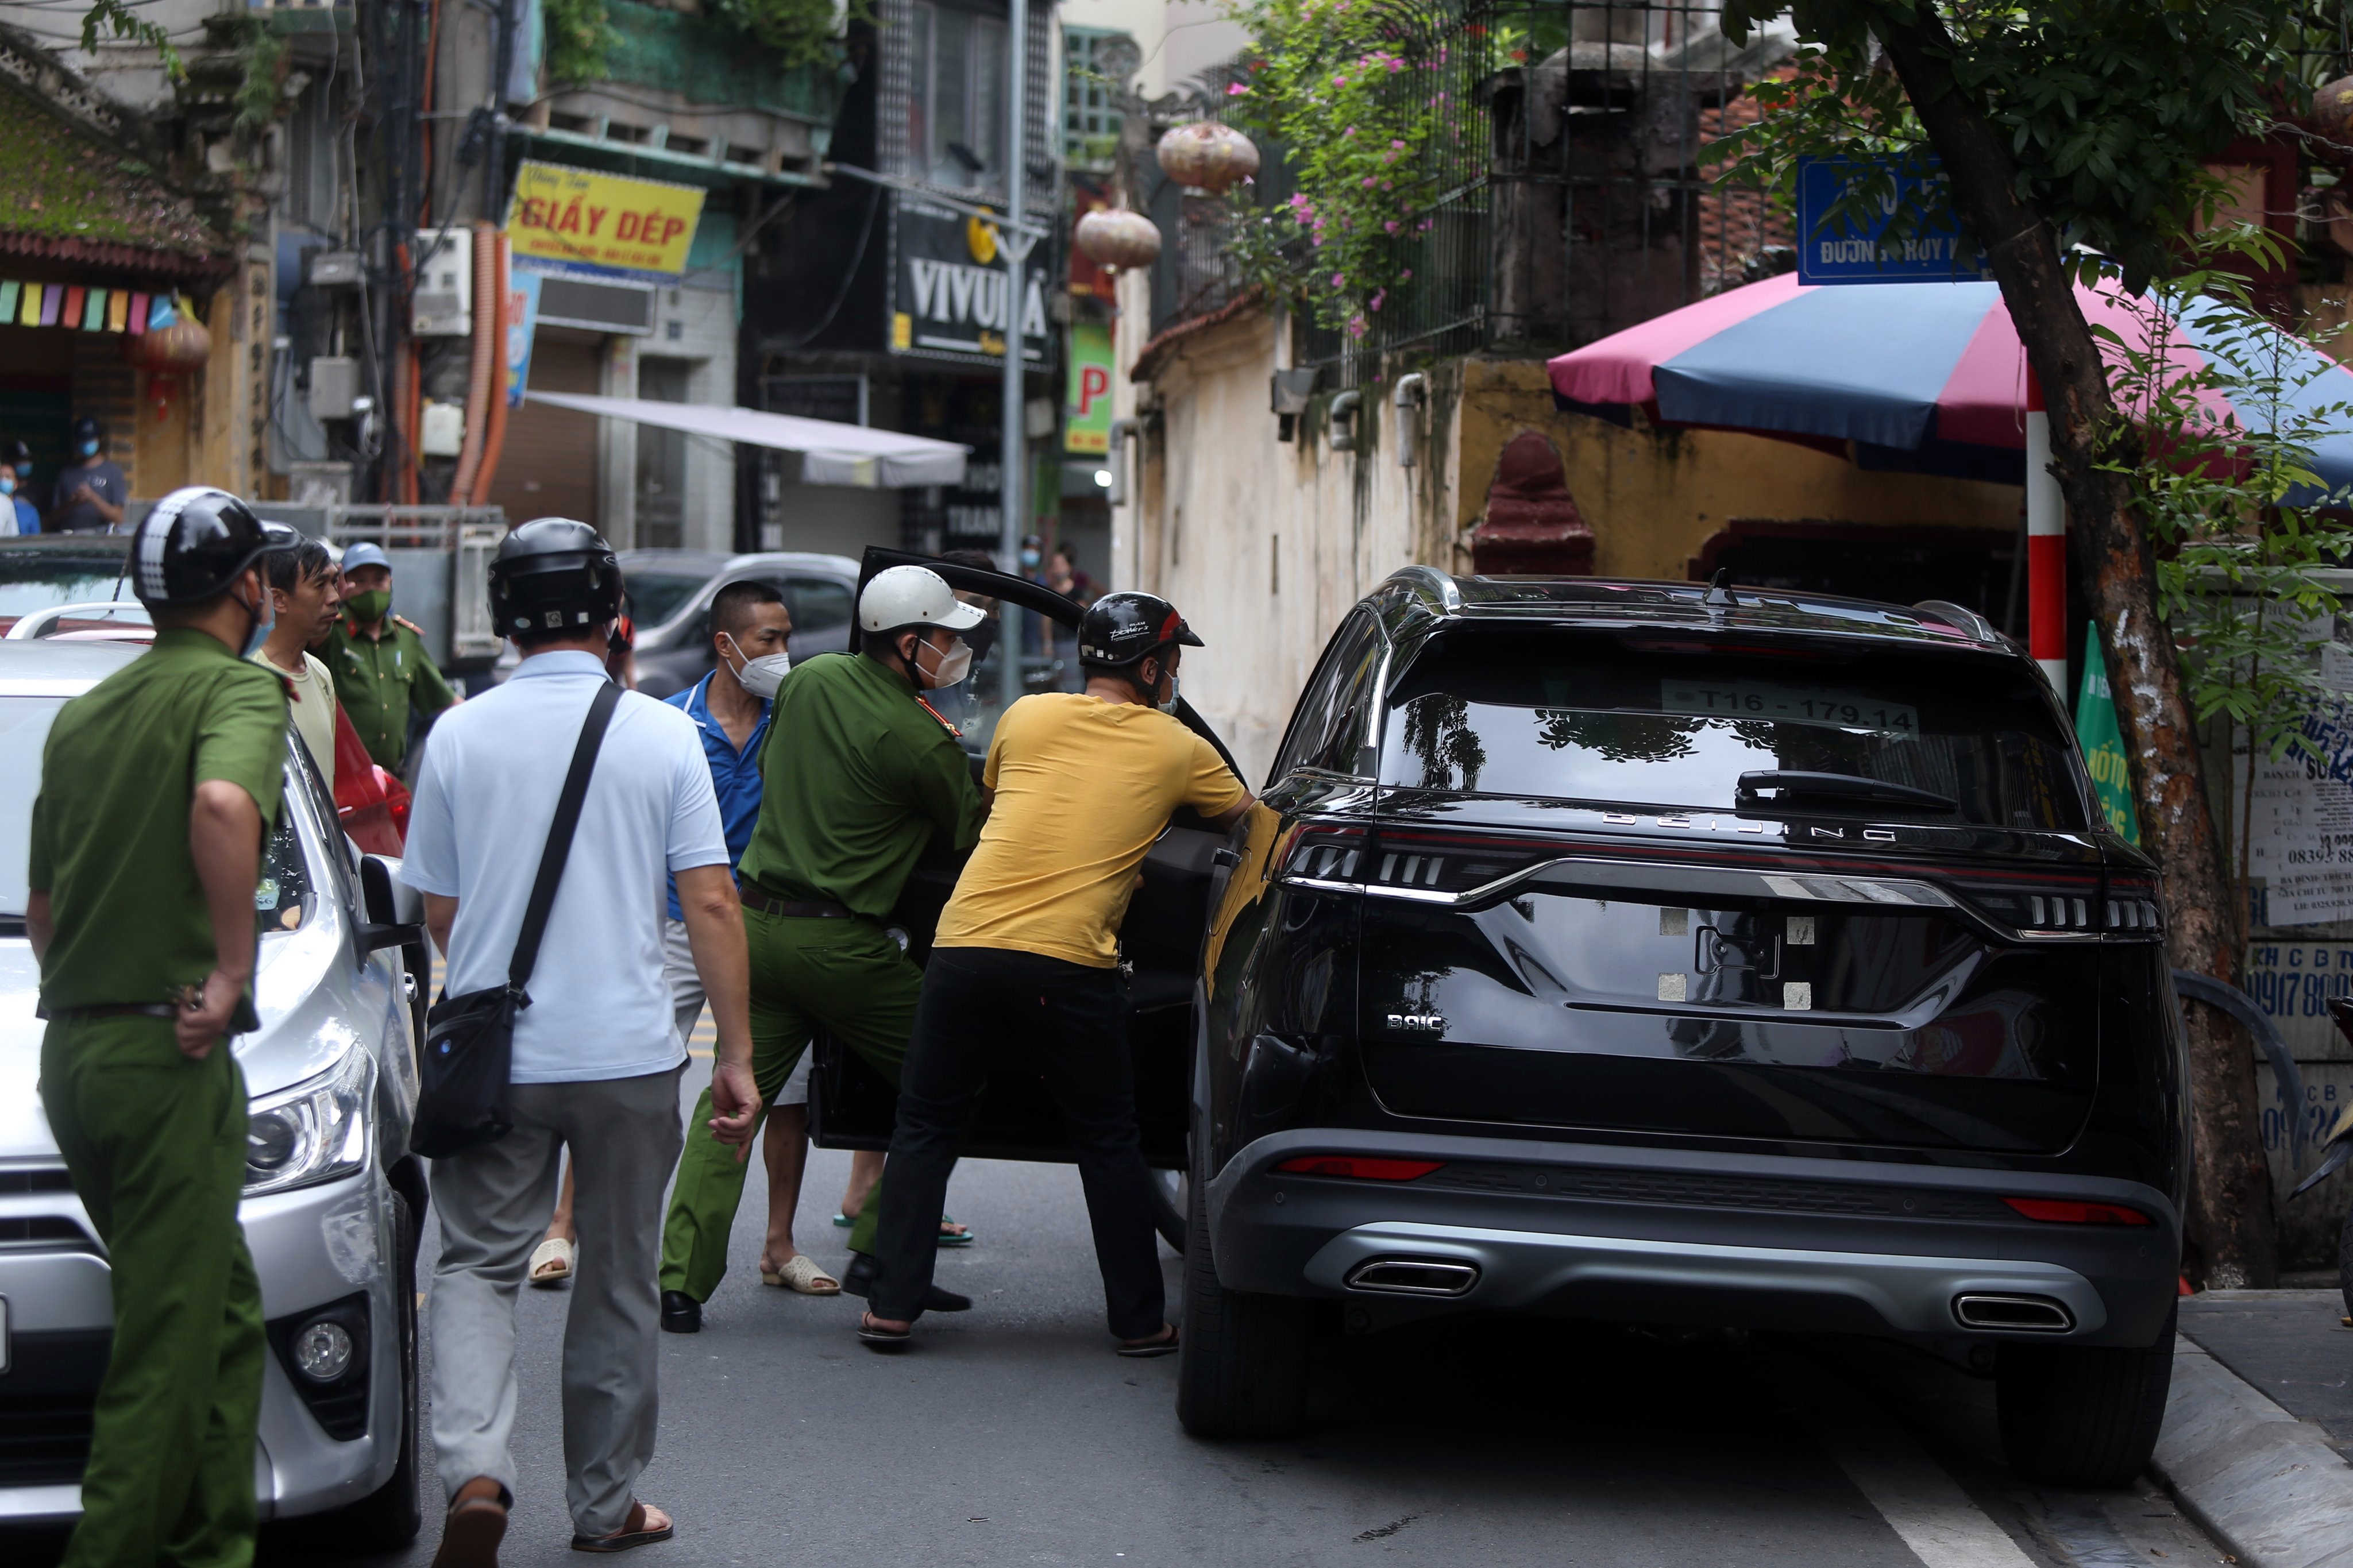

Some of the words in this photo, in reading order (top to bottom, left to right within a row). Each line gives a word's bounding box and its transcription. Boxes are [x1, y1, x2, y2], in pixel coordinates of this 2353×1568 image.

[616, 207, 686, 247] DÉP
[1901, 238, 1943, 267] HỤY
[1699, 689, 1764, 712] T16
[1800, 698, 1913, 731] 179.14
[1386, 1014, 1442, 1032] BAIC
